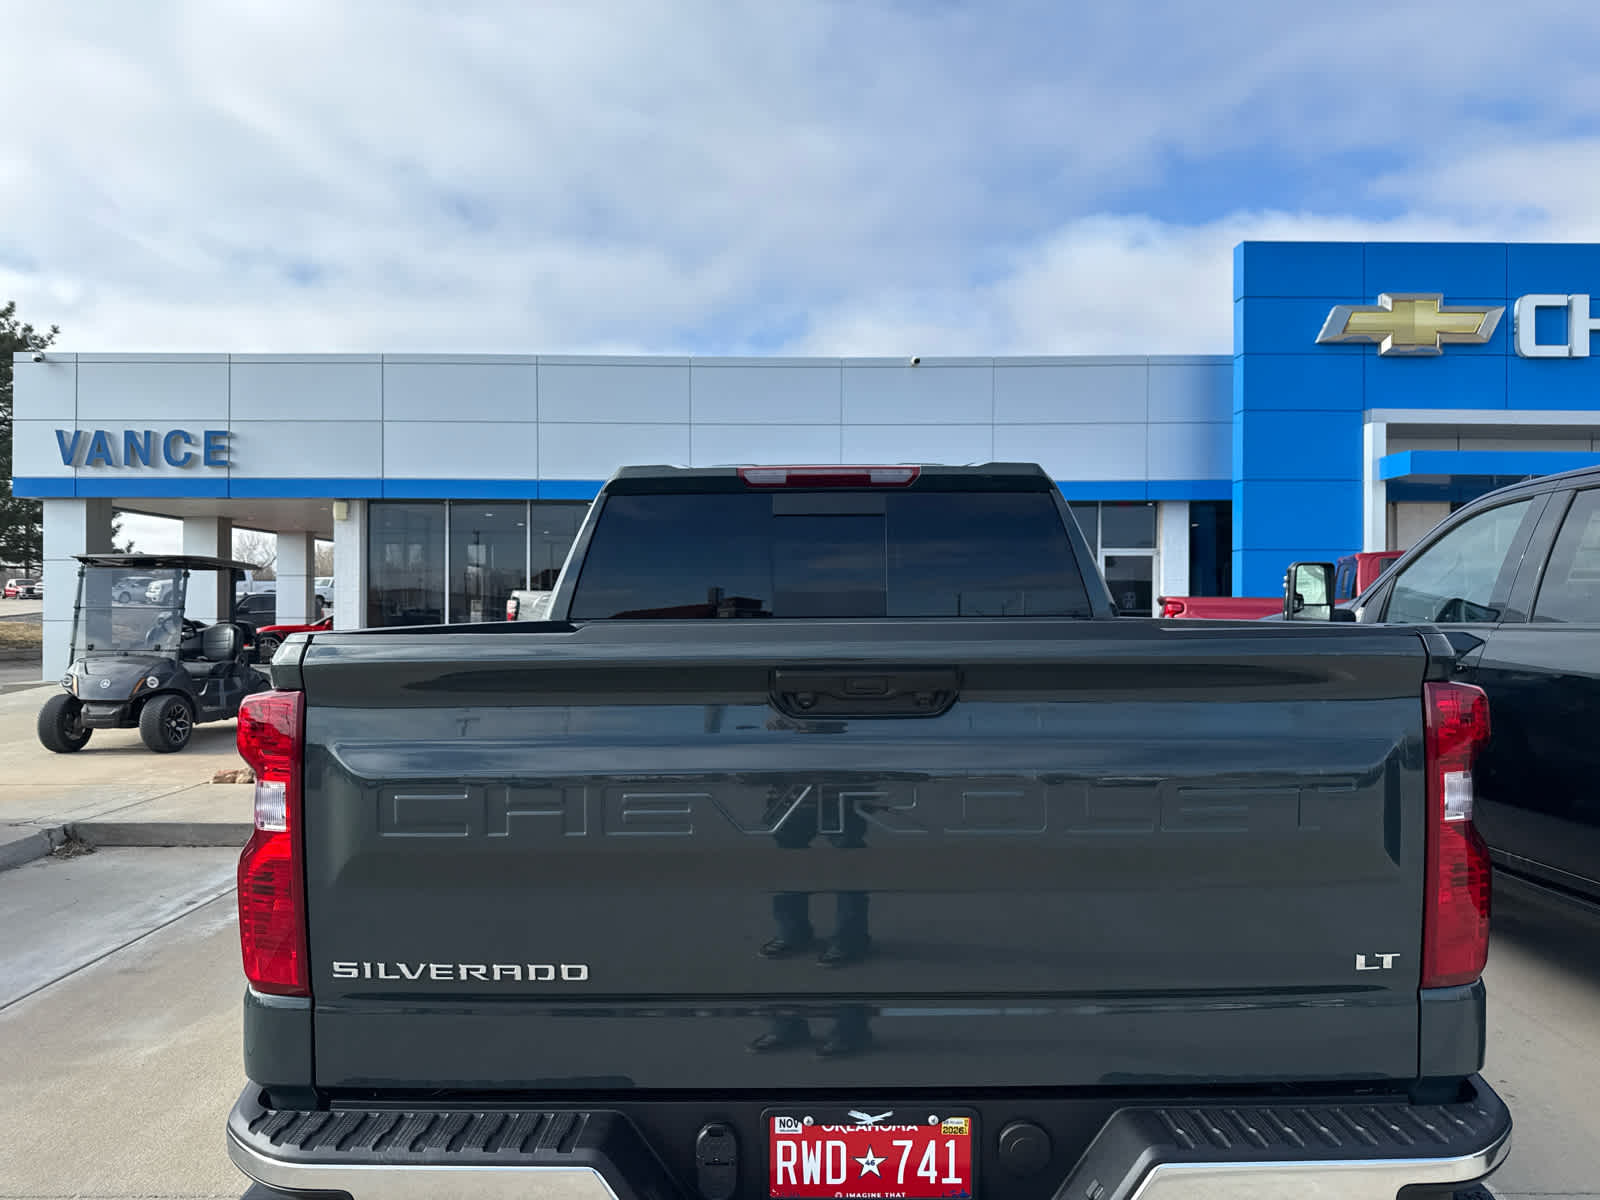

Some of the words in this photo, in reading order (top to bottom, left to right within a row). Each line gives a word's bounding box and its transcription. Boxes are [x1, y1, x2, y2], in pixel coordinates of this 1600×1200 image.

[55, 429, 232, 467] VANCE
[376, 783, 1356, 839] CHEVROLET
[332, 961, 588, 981] SILVERADO
[1356, 953, 1400, 970] LT
[779, 1119, 799, 1128] NOV
[943, 1126, 964, 1134] 2026
[776, 1140, 847, 1185] RWD
[892, 1139, 962, 1185] 741
